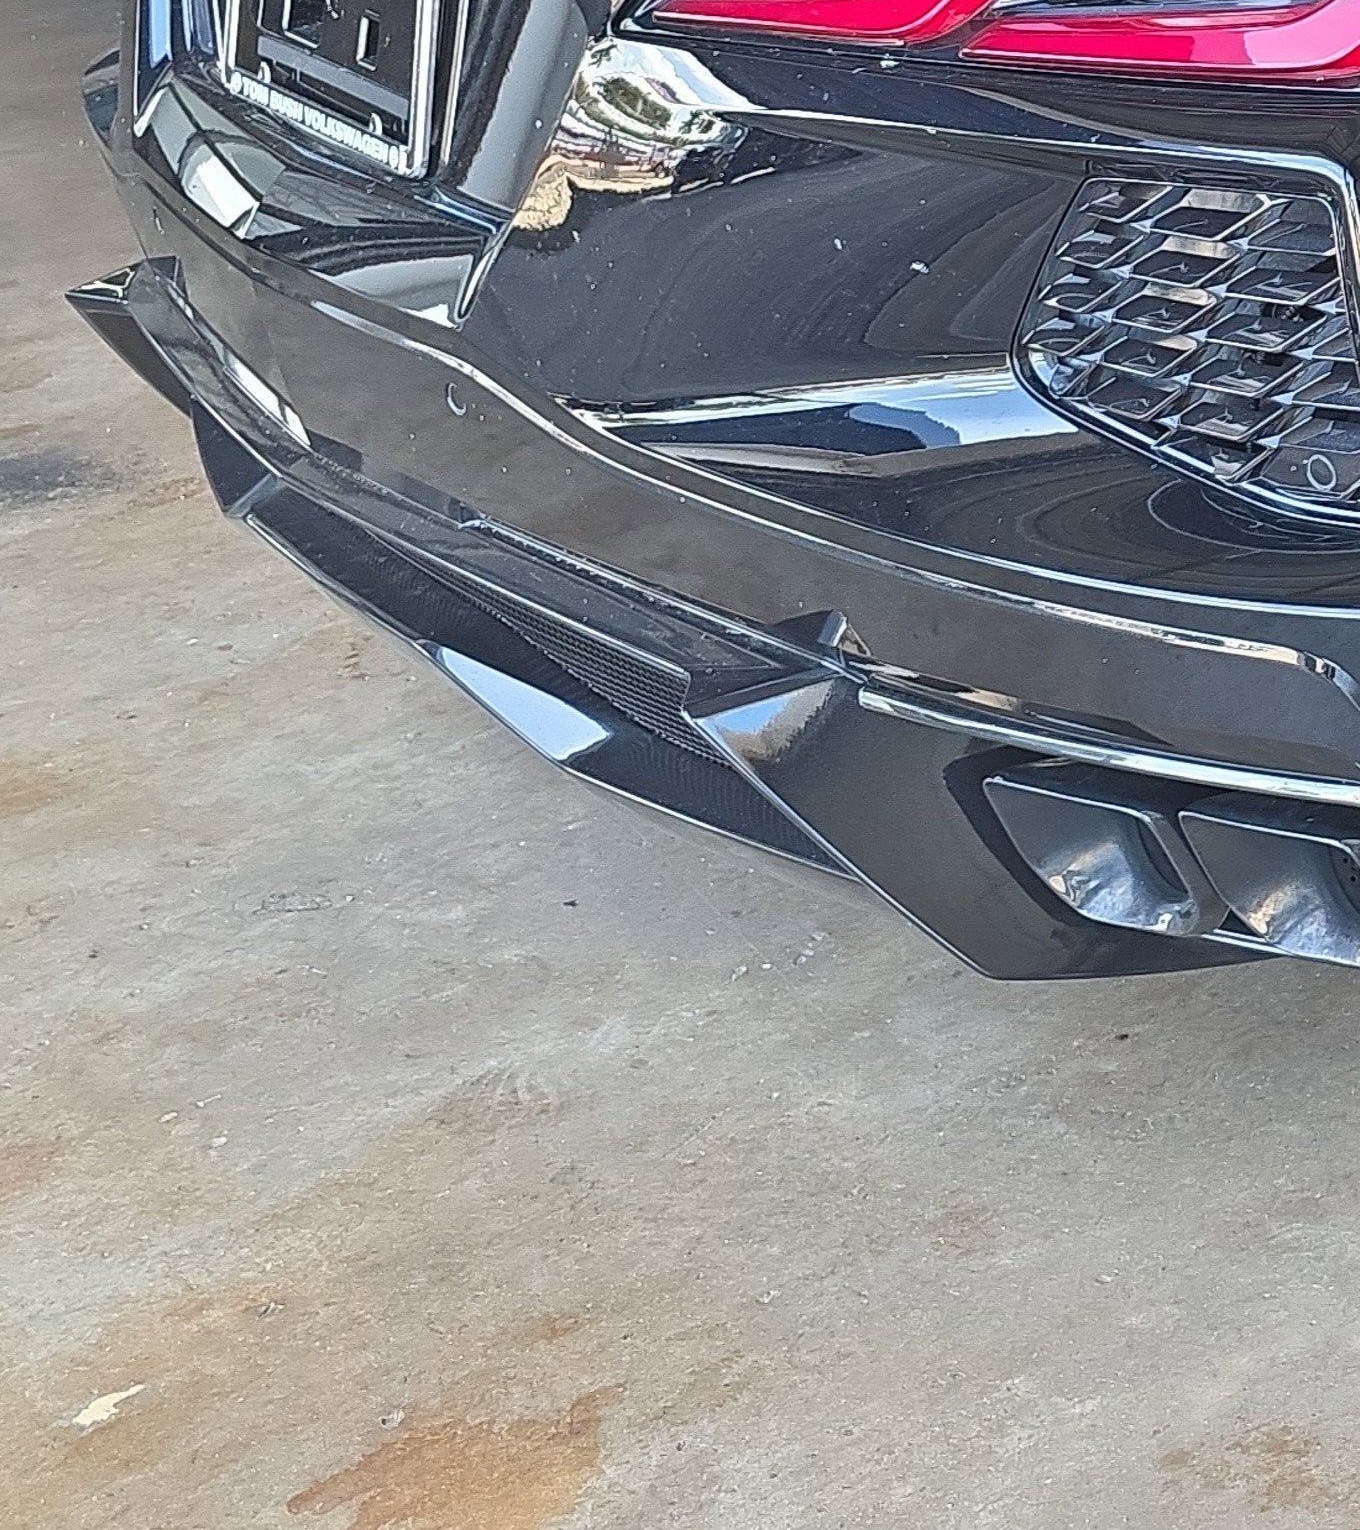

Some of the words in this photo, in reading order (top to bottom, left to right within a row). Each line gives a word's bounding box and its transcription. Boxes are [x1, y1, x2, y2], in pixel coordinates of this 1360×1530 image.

[241, 75, 270, 108] TOM
[269, 89, 304, 123] BUSH
[303, 105, 390, 163] VOLKSWAGEN
